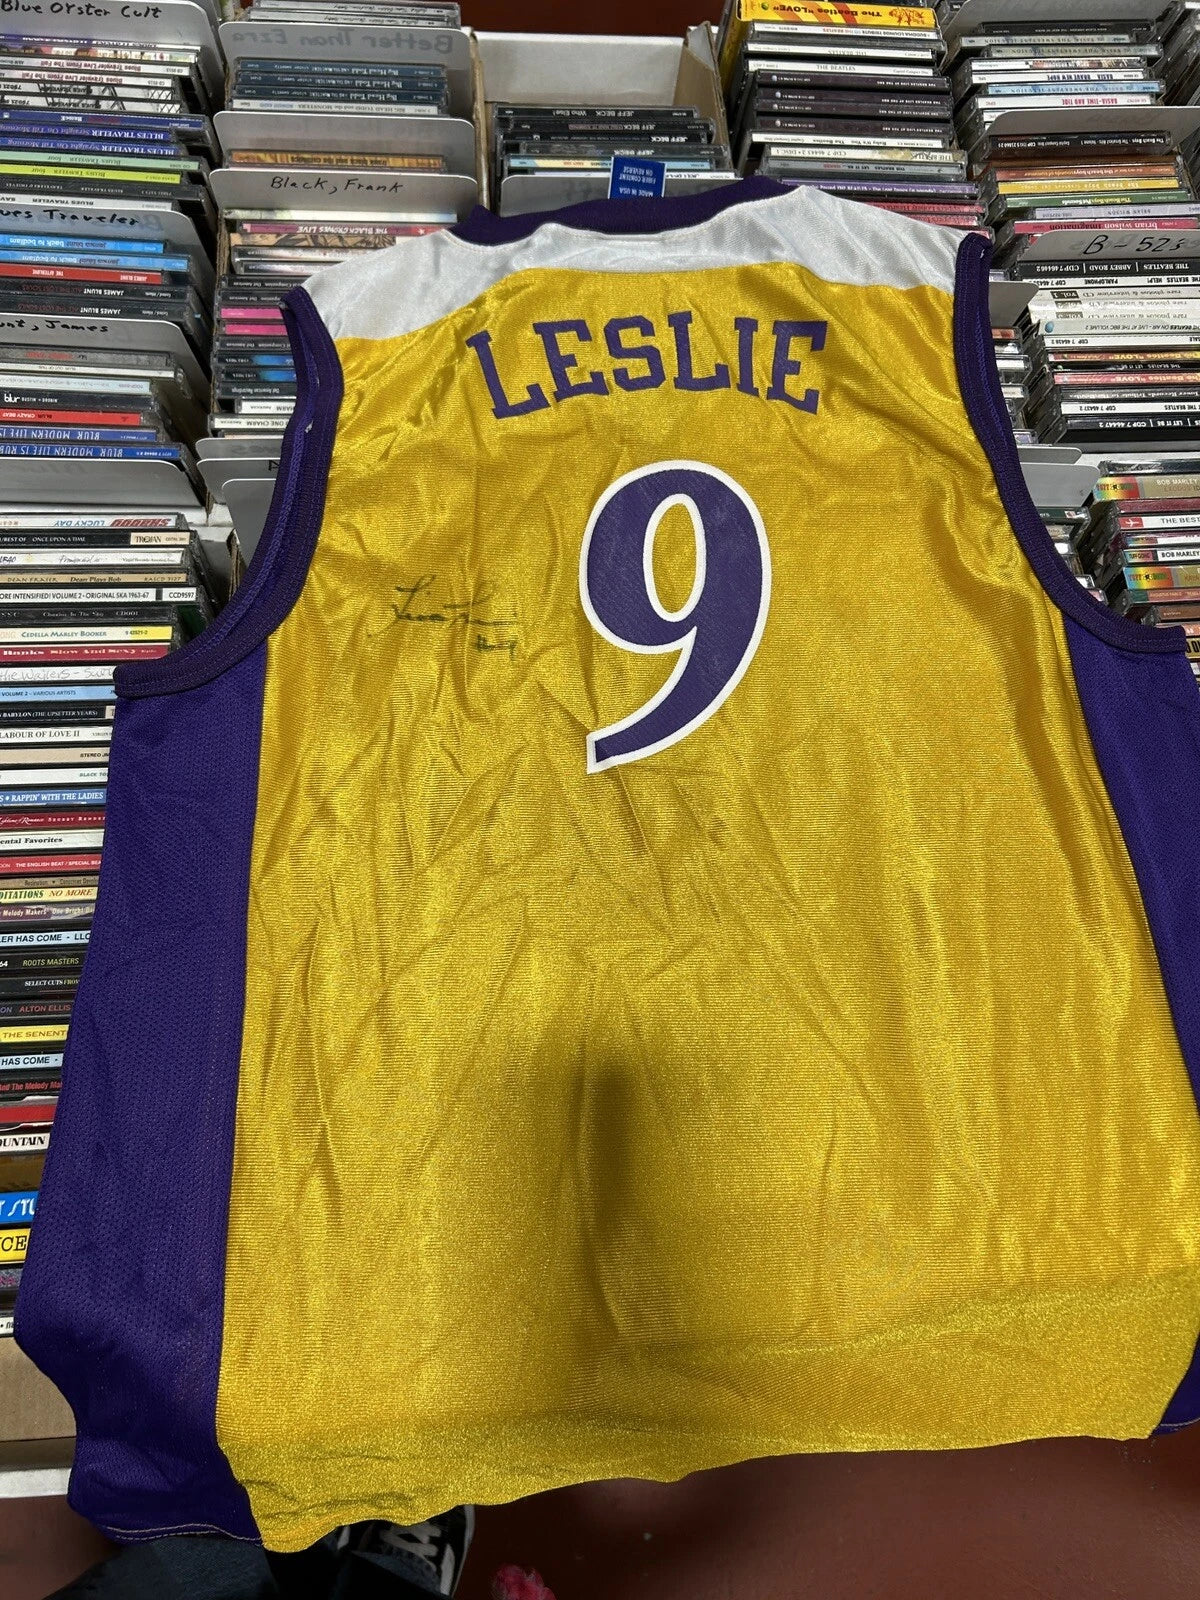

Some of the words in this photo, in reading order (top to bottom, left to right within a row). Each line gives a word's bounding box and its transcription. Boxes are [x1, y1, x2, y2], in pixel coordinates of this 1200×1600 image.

[121, 4, 162, 19] Cult
[773, 4, 813, 14] "LOVE"
[818, 8, 858, 18] Beatles
[862, 10, 882, 18] The
[91, 129, 135, 138] TRAVELER
[137, 131, 163, 140] BLUES
[101, 145, 145, 154] TRAVELER
[147, 148, 174, 156] BLUES
[623, 166, 644, 174] REVERSE
[620, 174, 642, 182] CONTENT
[344, 178, 404, 193] Frank
[44, 209, 140, 225] Traveler
[318, 226, 348, 234] CROWES
[1050, 222, 1102, 231] Imagination
[1134, 222, 1158, 230] brian
[1083, 234, 1108, 254] B
[45, 319, 108, 332] James
[465, 311, 828, 419] LESLIE
[10, 429, 28, 438] LIFE
[32, 430, 70, 439] MODERN
[76, 431, 100, 440] BLUR
[20, 446, 29, 454] IS
[33, 446, 50, 455] LIFE
[55, 447, 94, 457] MODERN
[100, 448, 123, 458] BLUR
[110, 518, 171, 528] SHAGGY
[579, 460, 772, 774] 9
[21, 670, 71, 681] Wailers
[11, 794, 40, 802] RAPPIN'
[3, 908, 23, 916] Melody
[25, 907, 47, 915] Makers
[47, 957, 79, 965] MASTERS
[23, 1056, 50, 1064] COME
